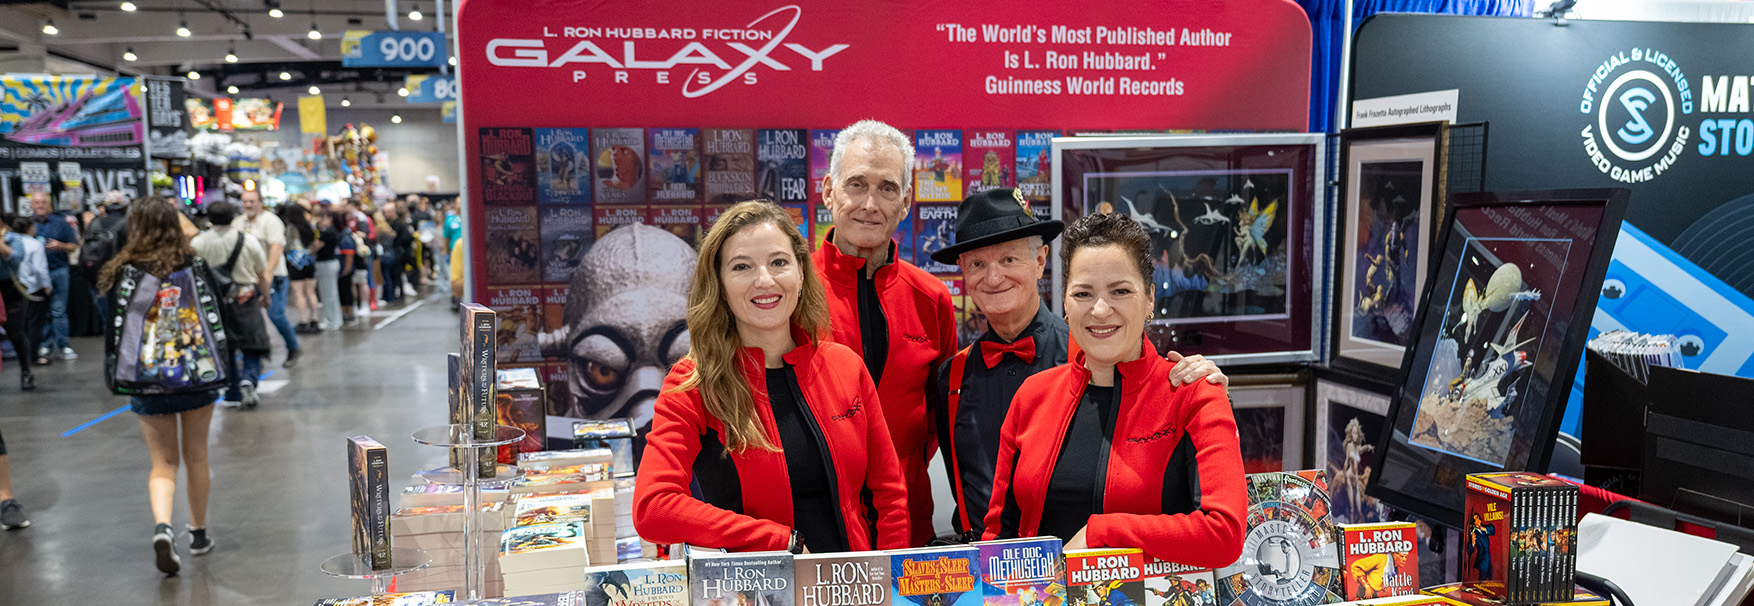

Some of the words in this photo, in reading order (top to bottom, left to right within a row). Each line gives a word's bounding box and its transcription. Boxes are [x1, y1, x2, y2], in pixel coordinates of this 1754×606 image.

[544, 27, 557, 38] L.
[564, 27, 602, 38] RON
[606, 28, 696, 40] HUBBARD
[703, 29, 772, 40] FICTION
[1051, 25, 1092, 45] Most
[1096, 26, 1175, 46] Published
[1179, 28, 1232, 47] Author
[380, 37, 435, 62] 900
[486, 38, 850, 71] GALAXY
[1004, 50, 1020, 69] Is
[1024, 50, 1040, 69] L.
[1046, 50, 1078, 70] Ron
[573, 71, 758, 85] PRESS
[1580, 50, 1630, 114] OFFICIAL
[1631, 47, 1643, 62] &
[1644, 48, 1694, 115] LICENSED
[985, 75, 1062, 95] Guinness
[1066, 76, 1115, 96] World
[1119, 77, 1185, 96] Records
[1700, 74, 1754, 113] MA
[1356, 110, 1368, 119] Frank
[1388, 104, 1419, 118] Autographed
[1420, 102, 1452, 114] Lithographs
[722, 130, 743, 142] RON
[766, 130, 774, 145] L.
[774, 131, 798, 144] RON
[918, 138, 959, 146] HUBBARD
[934, 132, 953, 140] RON
[986, 132, 1005, 140] RON
[707, 142, 751, 154] HUBBARD
[970, 139, 1011, 148] HUBBARD
[758, 145, 806, 160] HUBBARD
[1580, 124, 1612, 174] VIDEO
[1610, 165, 1654, 184] GAME
[1653, 125, 1691, 176] MUSIC
[708, 172, 751, 182] BUCKSKIN
[781, 178, 807, 200] FEAR
[918, 186, 949, 194] ENEMY
[598, 216, 644, 224] HUBBARD
[654, 216, 700, 224] HUBBARD
[672, 209, 692, 217] RON
[919, 210, 958, 220] EARTH
[490, 296, 540, 305] HUBBARD
[509, 290, 532, 298] RON
[1486, 502, 1497, 512] VILE
[1483, 510, 1504, 522] VILLAINS!
[1360, 532, 1372, 543] L.
[1373, 530, 1403, 542] RON
[1003, 548, 1021, 560] OLE
[1022, 546, 1042, 558] DOC
[1350, 540, 1414, 556] HUBBARD
[904, 558, 936, 577] SLAVES
[940, 557, 968, 574] SLEEP
[988, 552, 1056, 581] METHUSELAH
[1082, 557, 1096, 570] L.
[1097, 555, 1129, 569] RON
[645, 574, 655, 584] L.
[658, 573, 682, 584] RON
[724, 568, 734, 580] L.
[734, 566, 766, 579] RON
[816, 564, 830, 586] L.
[832, 562, 870, 584] RON
[1072, 566, 1140, 584] HUBBARD
[1382, 572, 1413, 588] Cattle
[702, 578, 788, 599] HUBBARD
[900, 576, 941, 594] MASTERS
[945, 576, 974, 592] SLEEP
[1252, 569, 1311, 596] STORYTELLER
[634, 584, 684, 597] HUBBARD
[803, 583, 885, 606] HUBBARD
